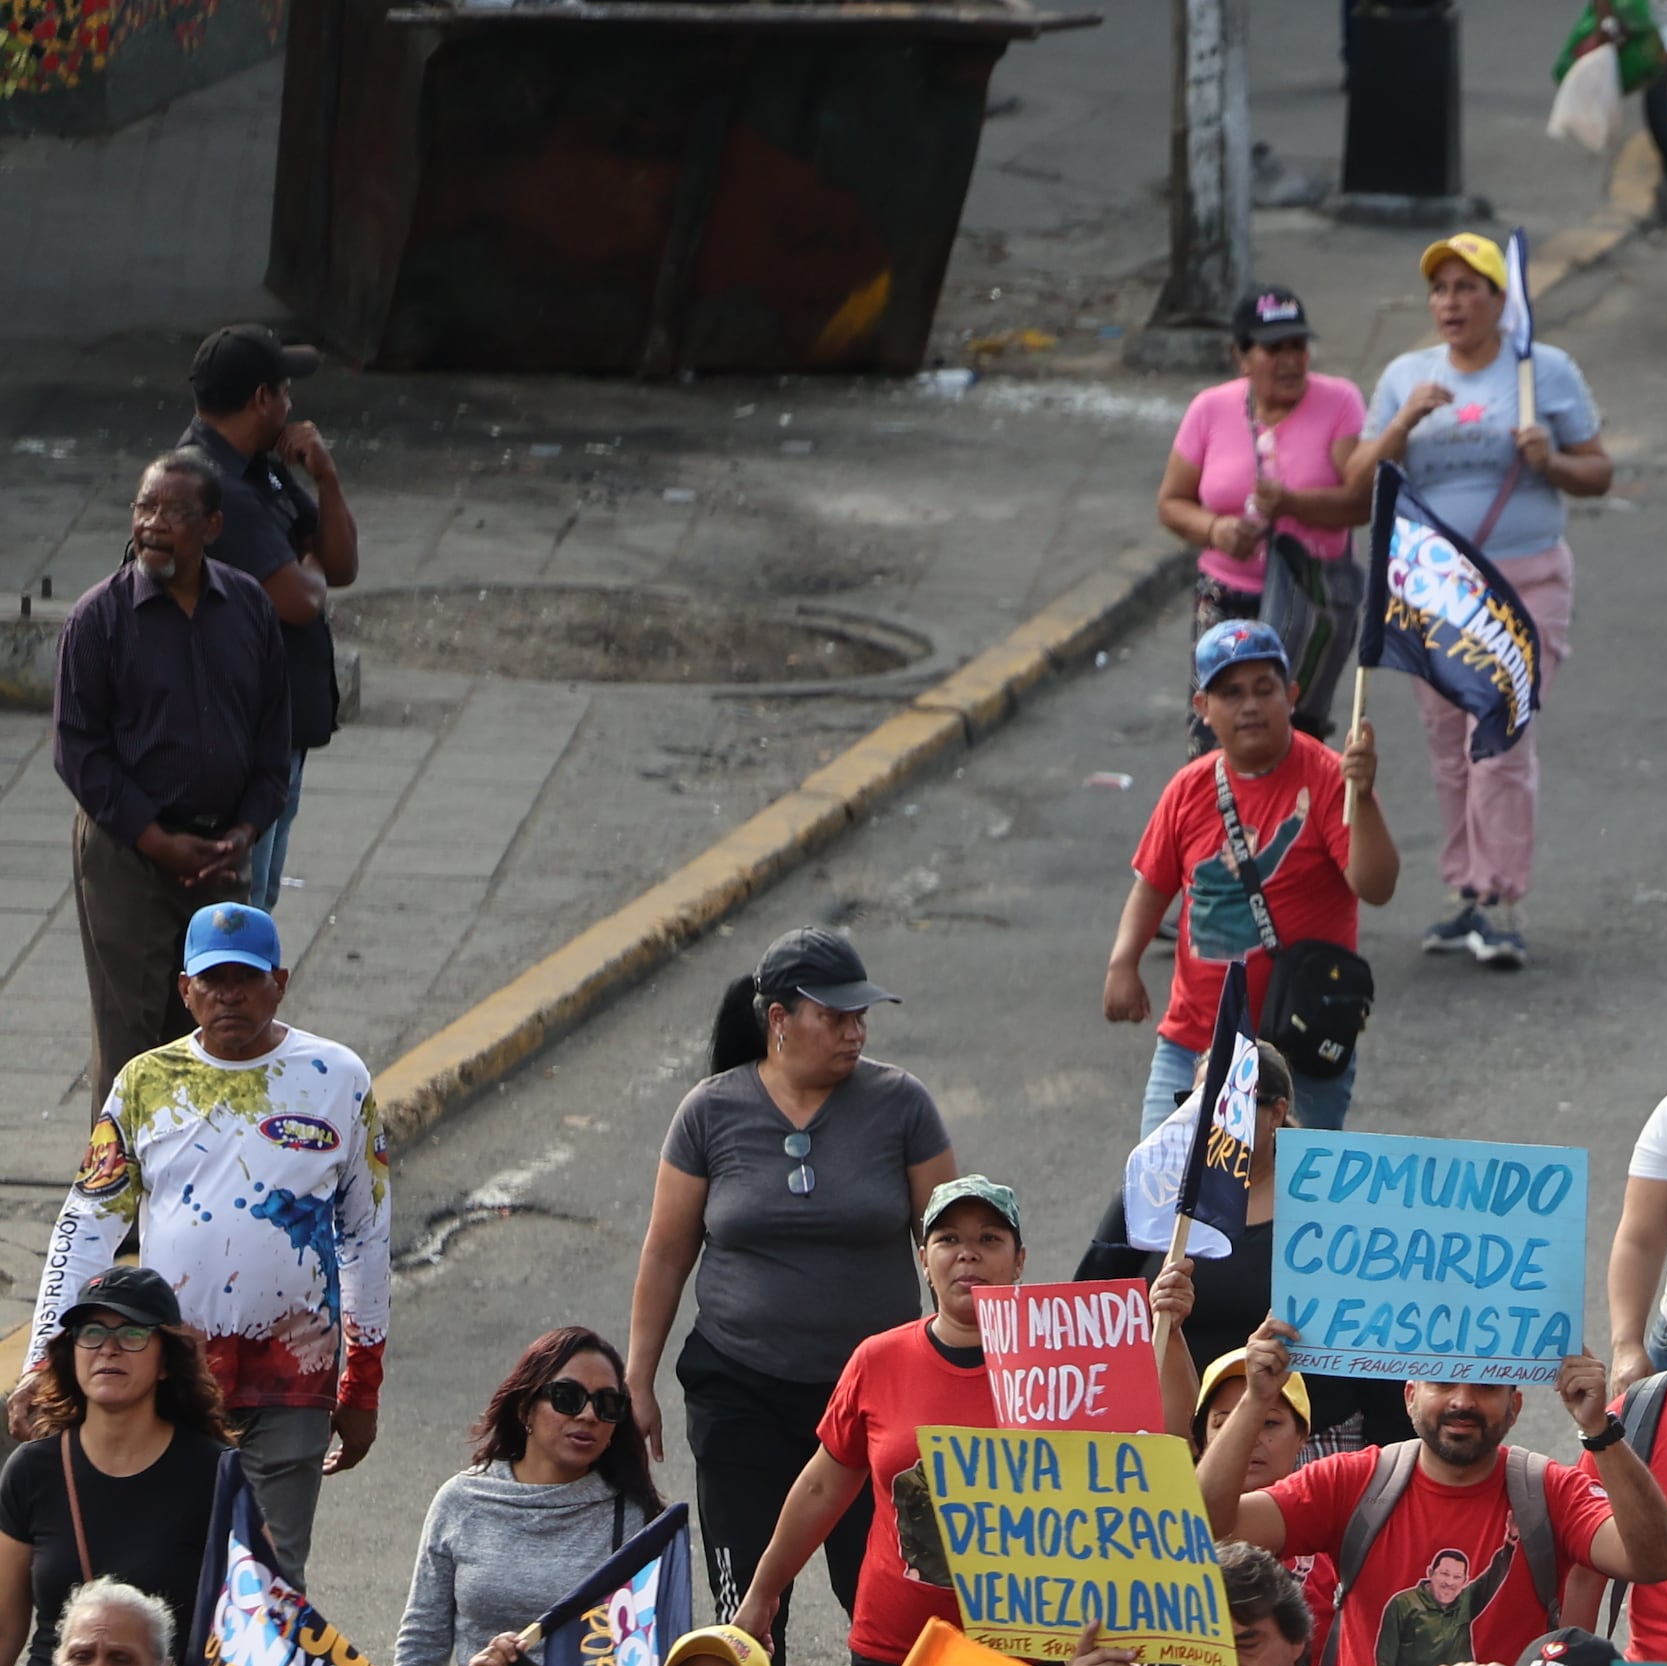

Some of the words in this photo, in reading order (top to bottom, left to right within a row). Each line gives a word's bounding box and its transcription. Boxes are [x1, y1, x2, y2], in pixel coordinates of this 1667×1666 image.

[1318, 1038, 1345, 1063] CAT
[1287, 1147, 1573, 1218] EDMUNDO
[1284, 1221, 1552, 1291] COBARDE
[1028, 1288, 1151, 1351] MANDA
[1323, 1298, 1573, 1359] FASCISTA
[1001, 1363, 1110, 1425] DECIDE
[1348, 1357, 1444, 1377] FRANCISCO
[1450, 1361, 1474, 1378] DE
[932, 1436, 1062, 1497] ¡VIVA
[1088, 1441, 1150, 1493] LA
[939, 1501, 1219, 1565] DEMOCRACIA
[954, 1571, 1221, 1637] VENEZOLANA!
[974, 1633, 1033, 1653] FRENTE
